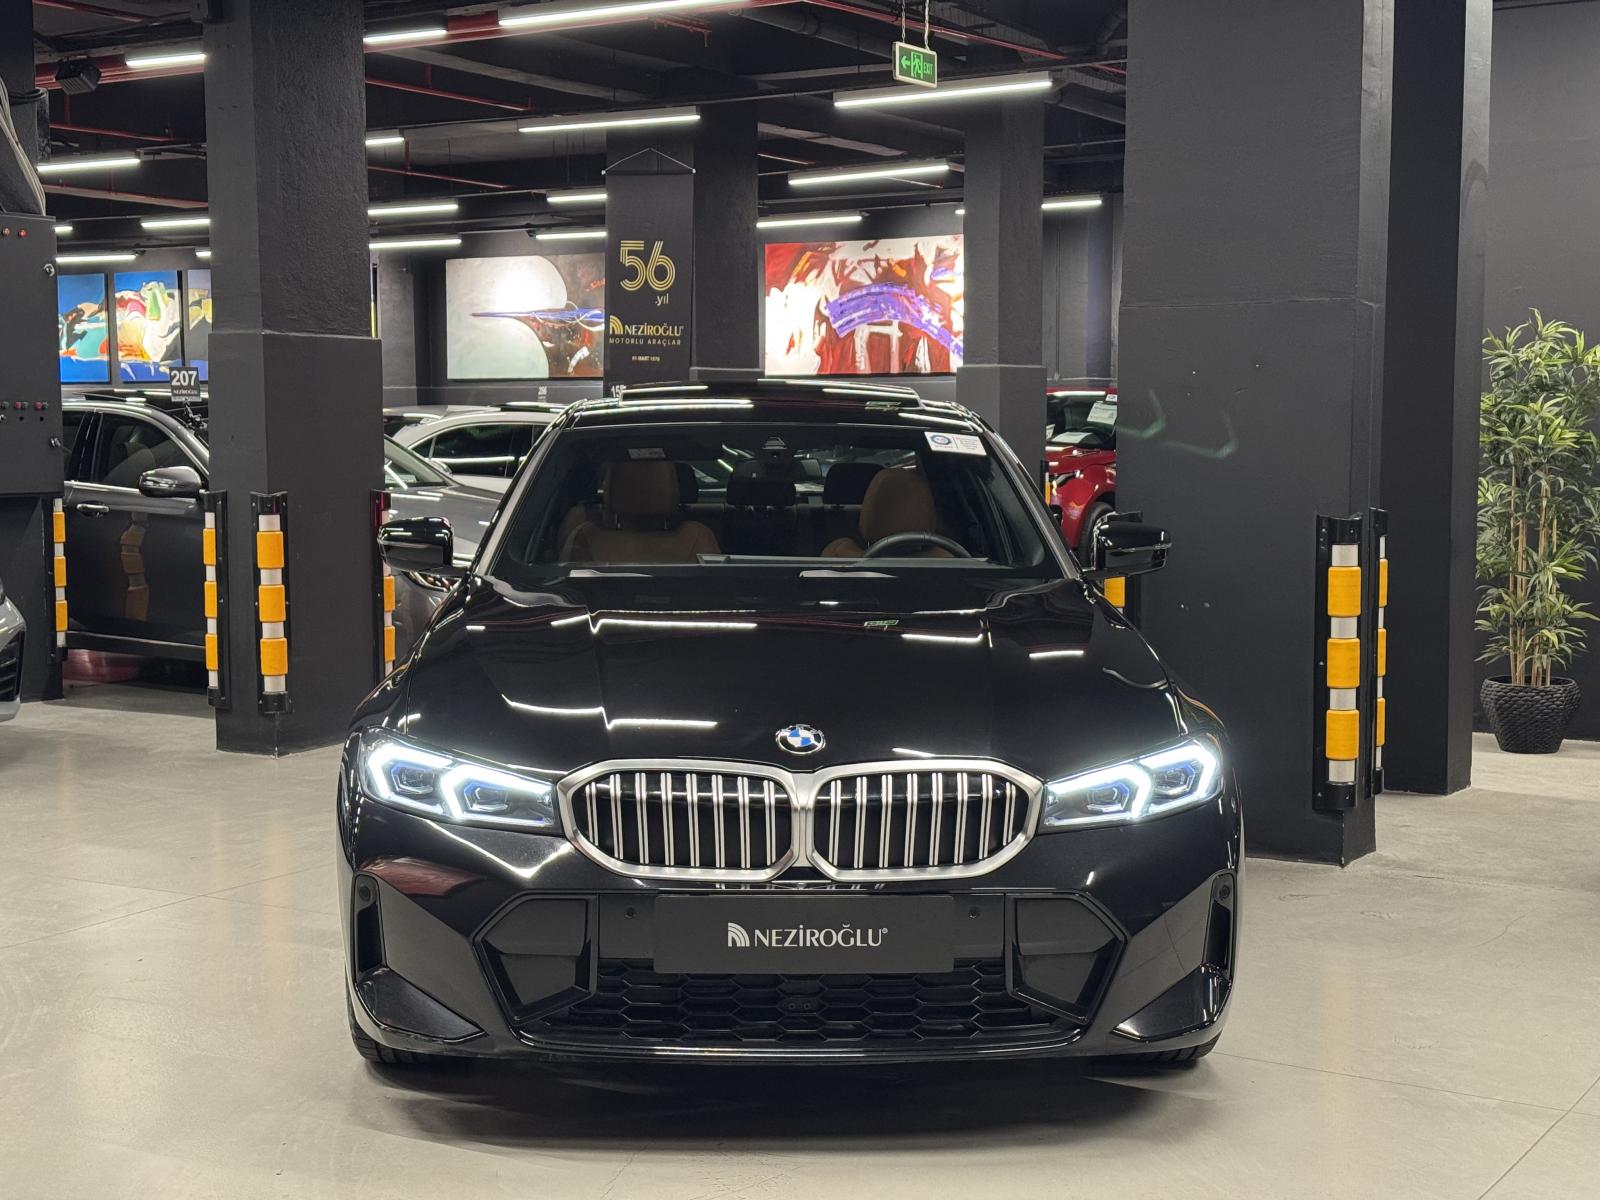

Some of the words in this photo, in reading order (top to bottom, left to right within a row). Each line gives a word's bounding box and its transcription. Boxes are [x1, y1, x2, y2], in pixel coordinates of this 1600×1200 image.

[923, 62, 934, 75] EXIT
[620, 240, 676, 291] 56
[609, 337, 644, 345] MOTORLU
[647, 338, 681, 347] ARAÇLAR
[170, 370, 198, 386] 207
